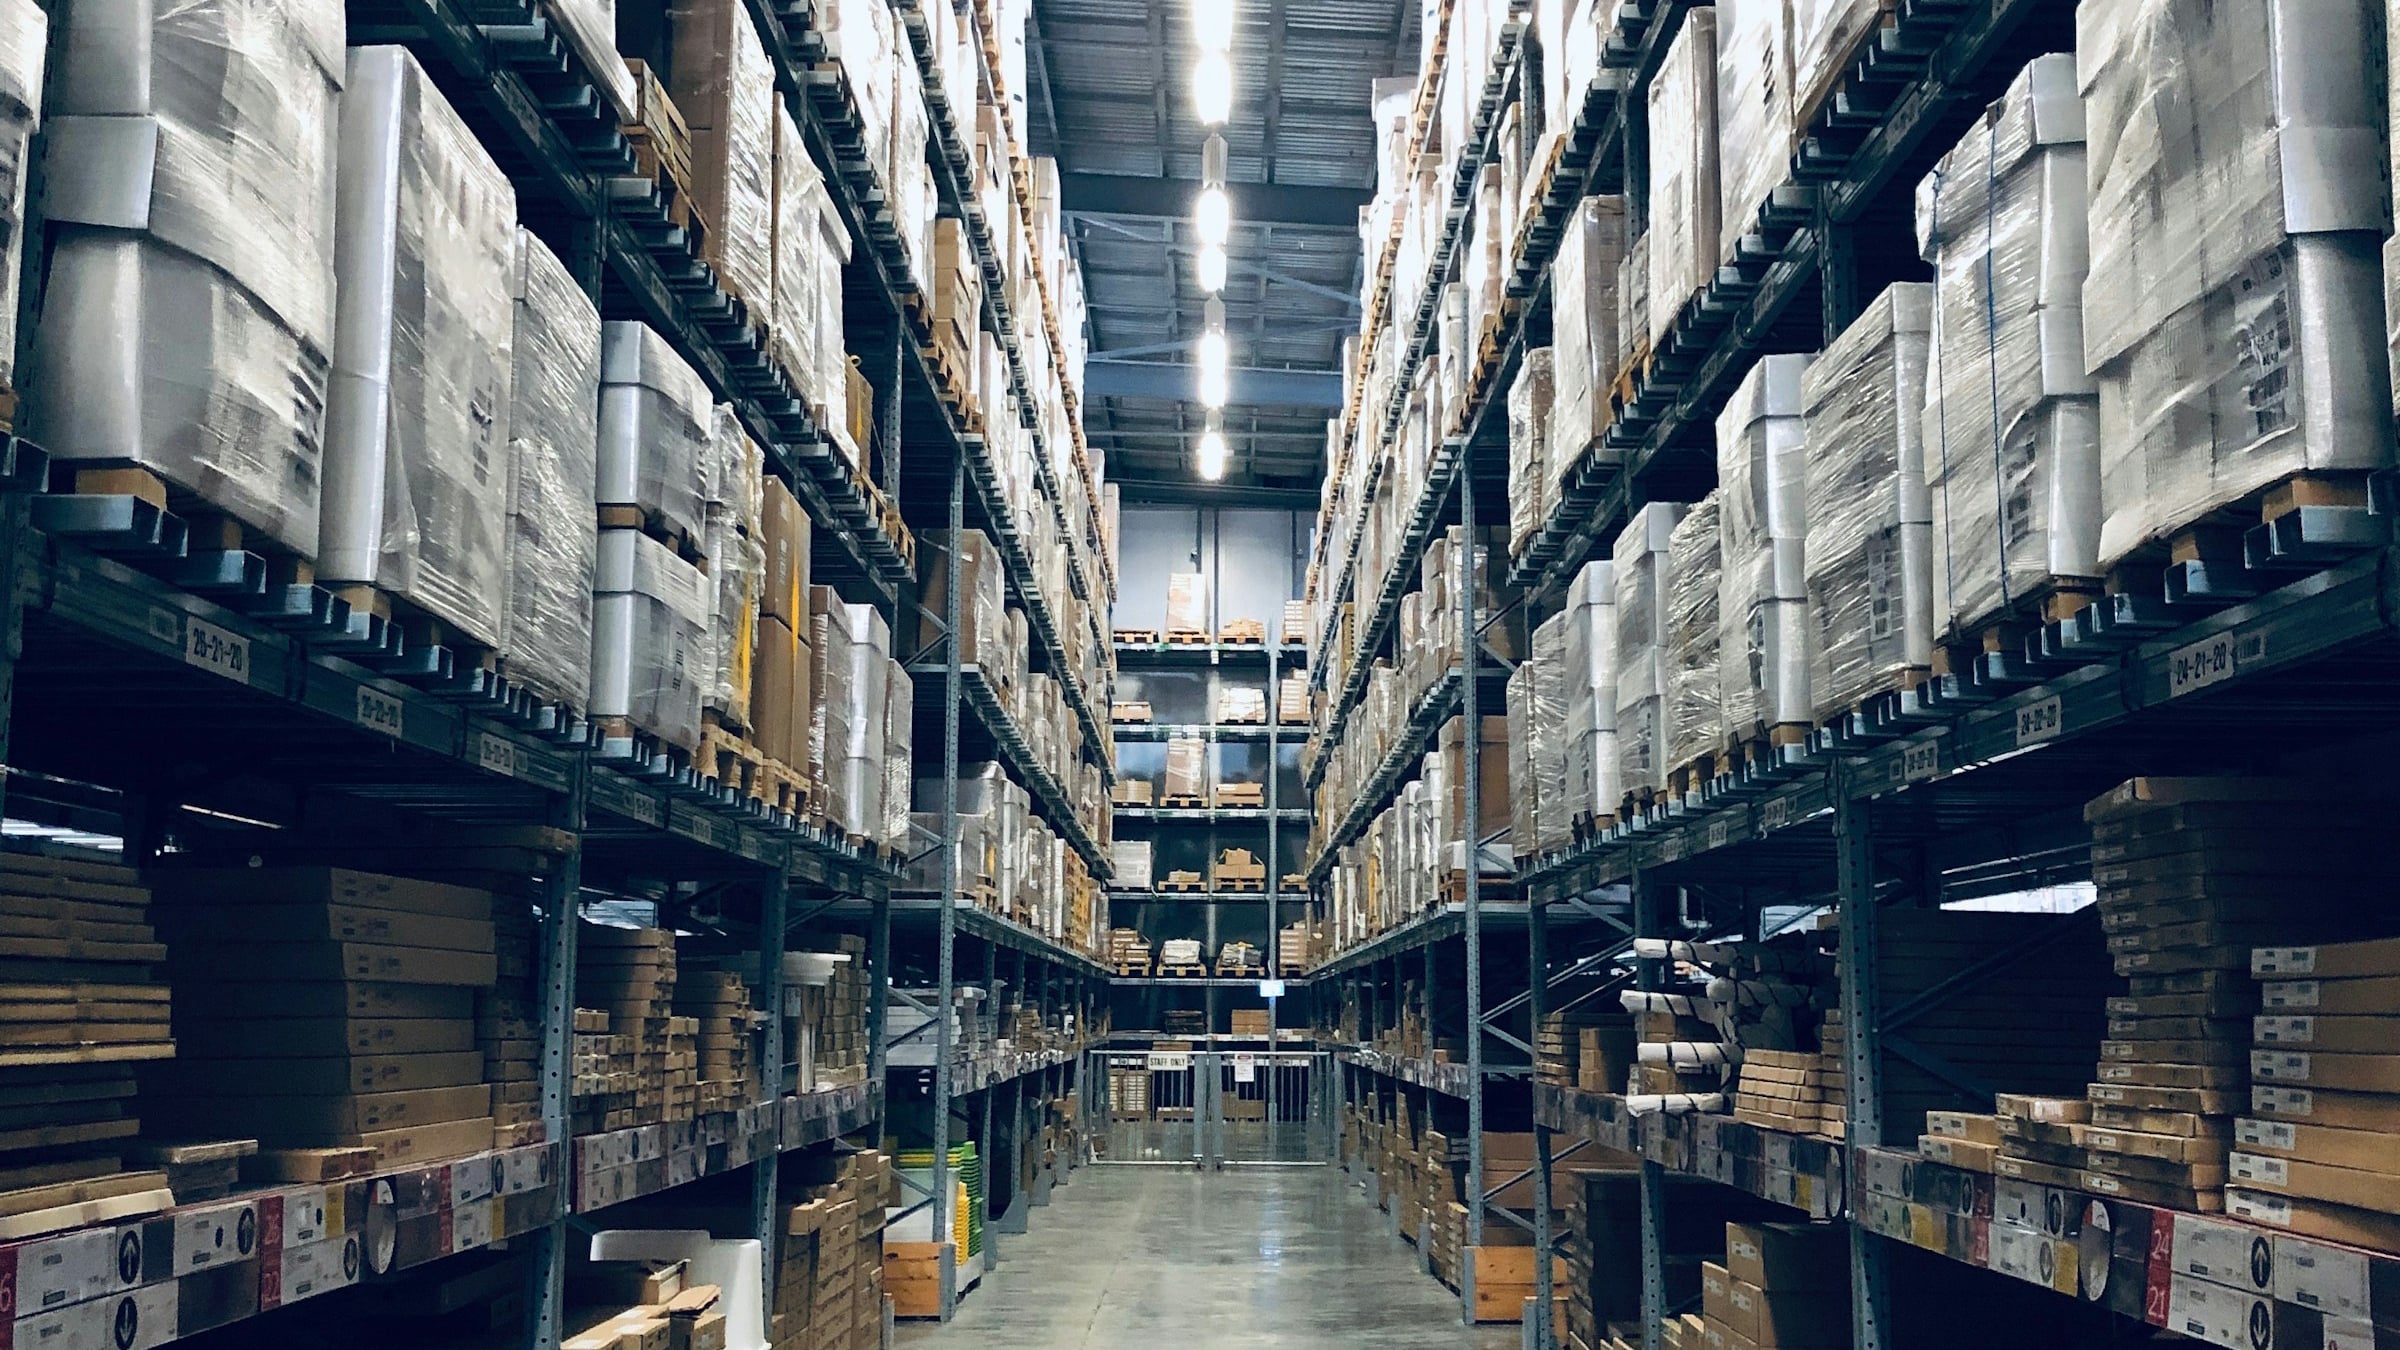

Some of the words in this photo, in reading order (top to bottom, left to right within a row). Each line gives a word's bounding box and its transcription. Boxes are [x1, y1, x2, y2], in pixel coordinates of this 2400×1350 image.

[2177, 641, 2227, 686] 24-21-20
[1150, 1057, 1168, 1066] STAFF
[1171, 1057, 1185, 1066] ONLY
[2151, 1228, 2170, 1260] 24
[2148, 1286, 2165, 1319] 21
